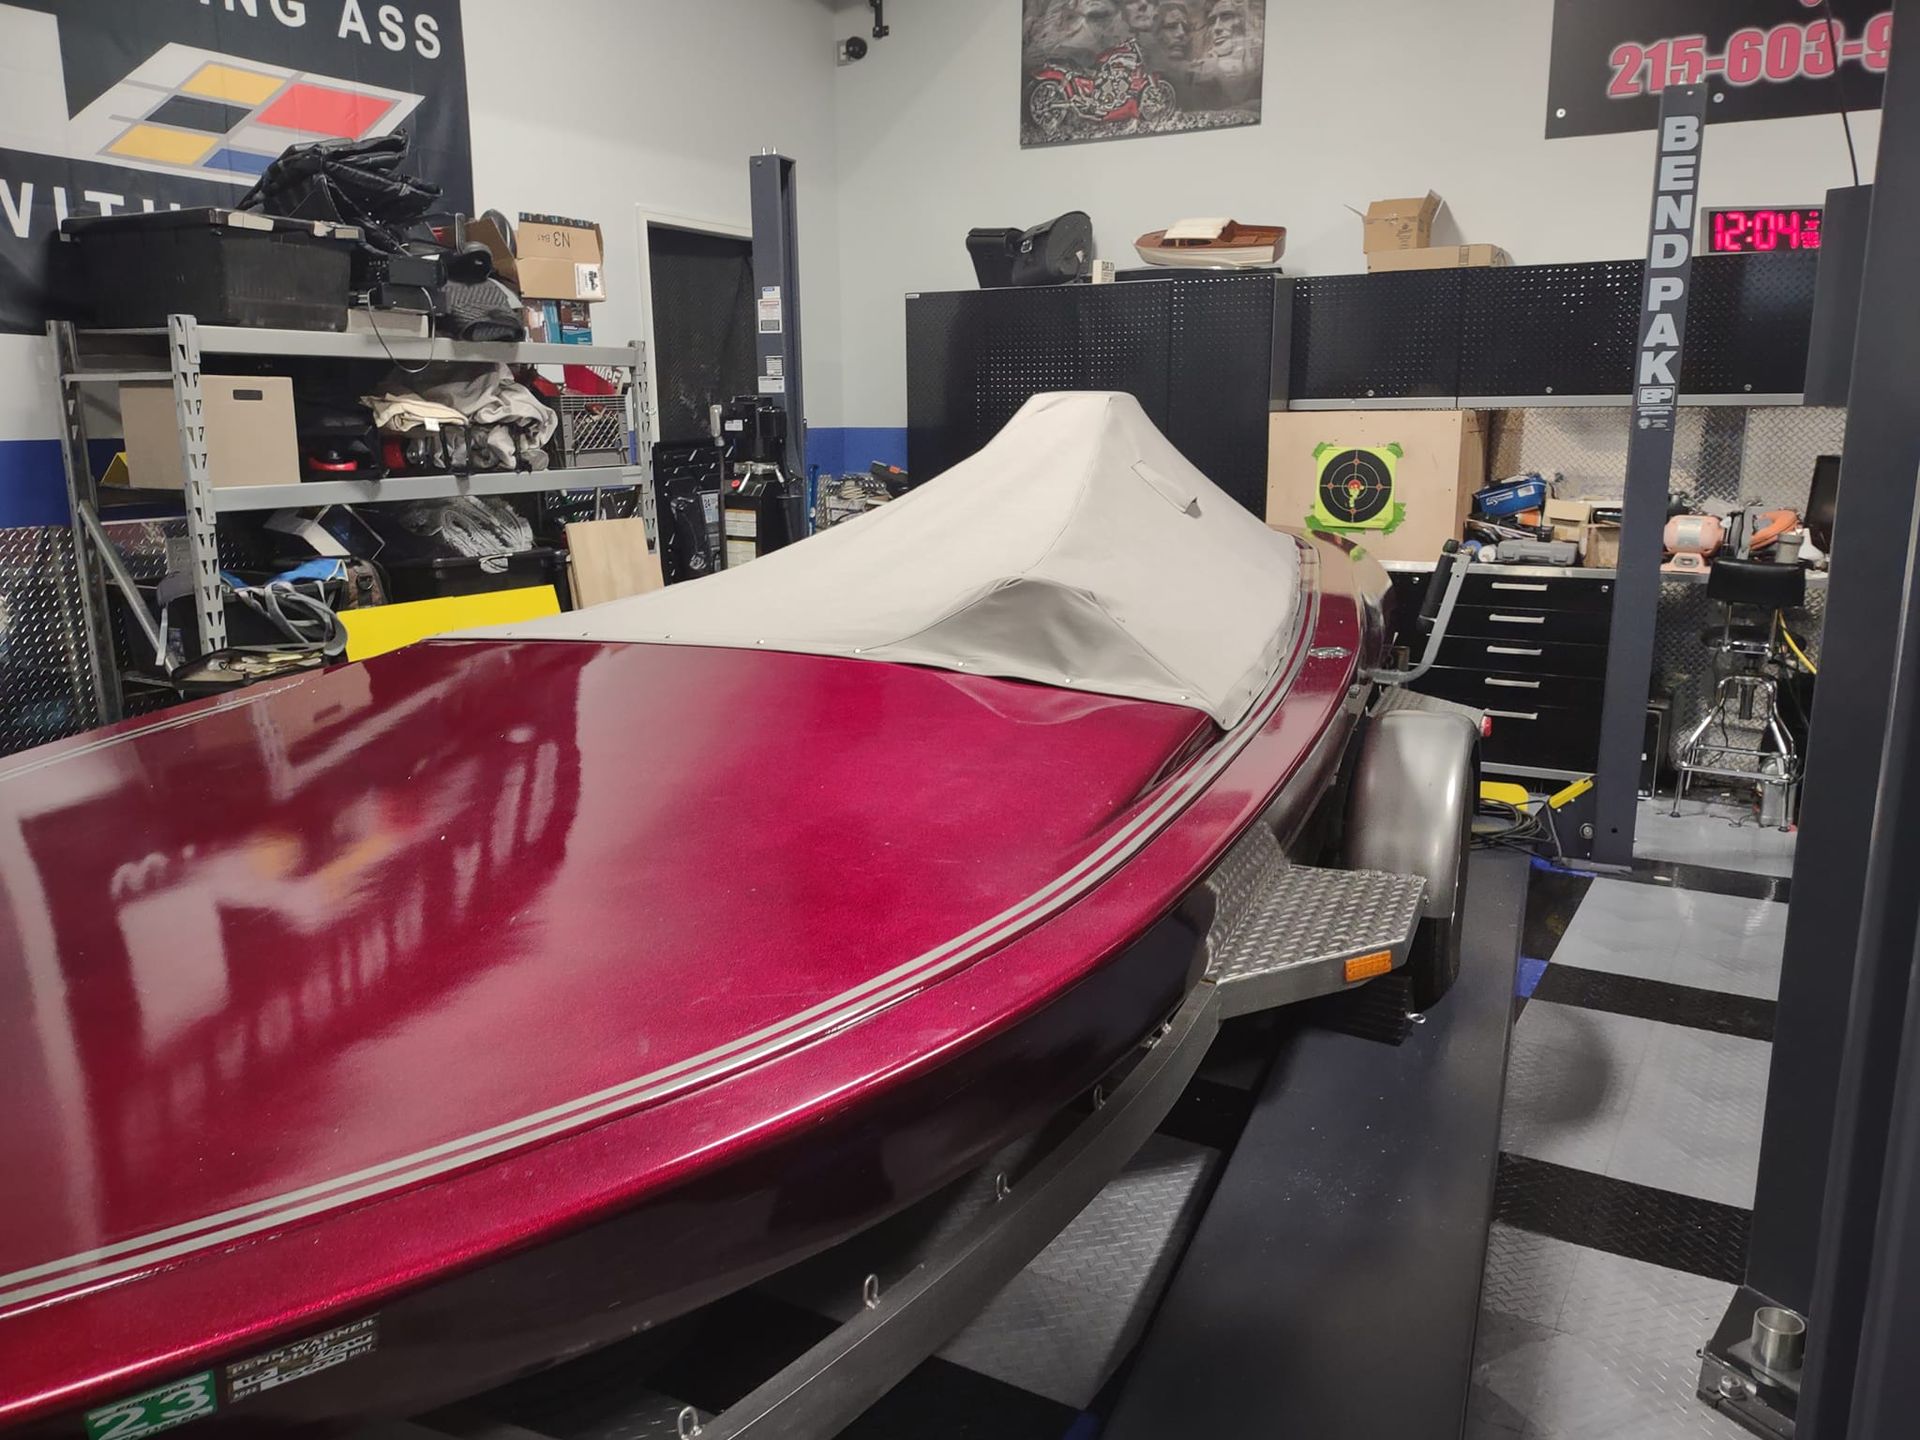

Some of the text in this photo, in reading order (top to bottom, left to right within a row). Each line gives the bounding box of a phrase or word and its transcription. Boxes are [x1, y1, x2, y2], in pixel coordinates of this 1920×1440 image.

[338, 0, 441, 60] ASS
[1638, 115, 1699, 385] BENDPAK
[1714, 210, 1801, 252] 12:04
[93, 1384, 211, 1440] 23
